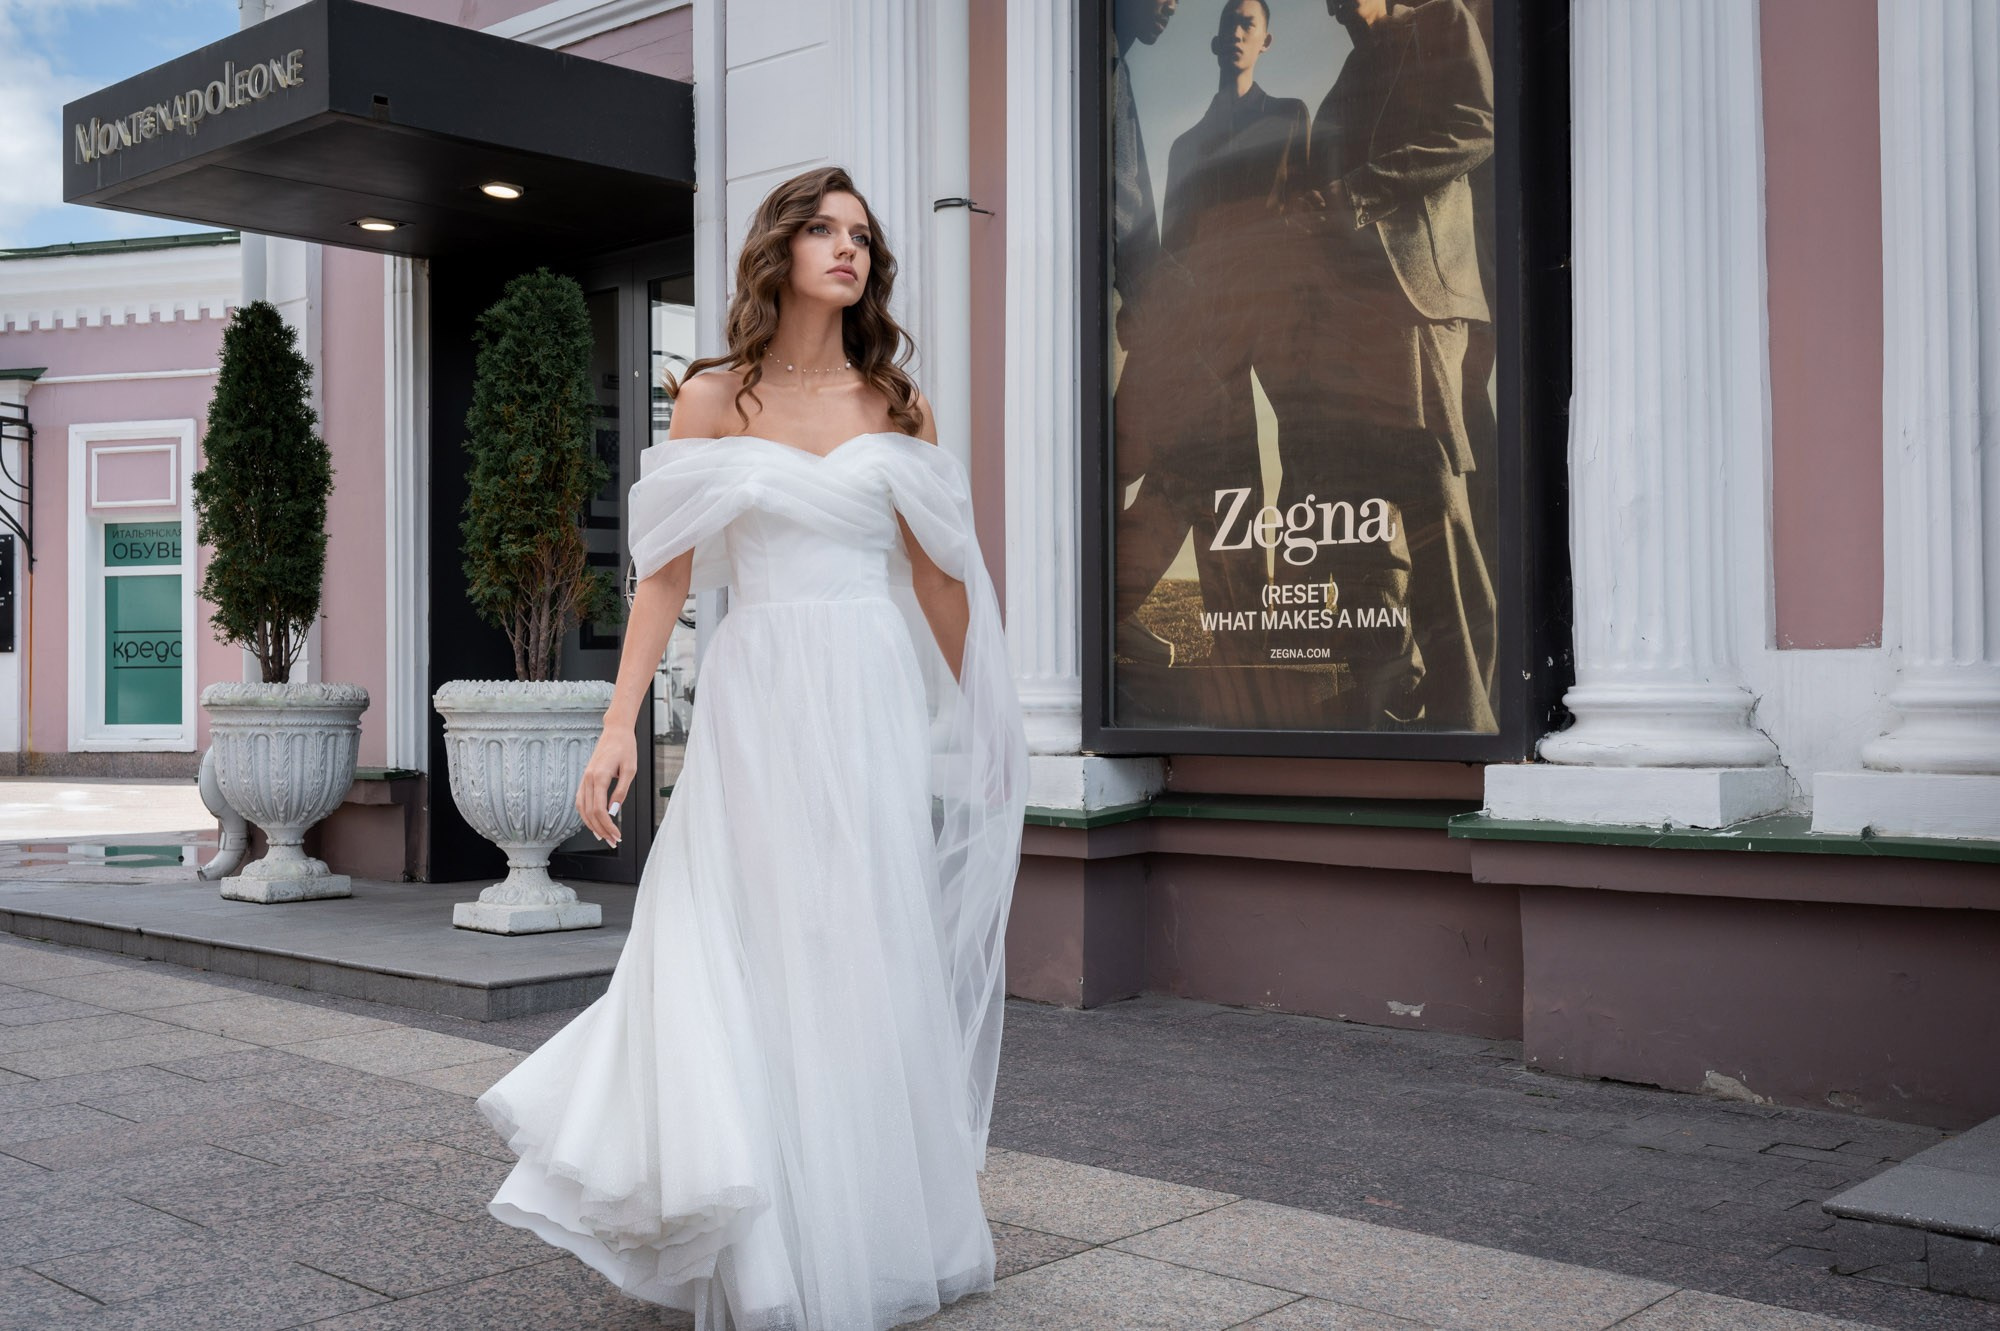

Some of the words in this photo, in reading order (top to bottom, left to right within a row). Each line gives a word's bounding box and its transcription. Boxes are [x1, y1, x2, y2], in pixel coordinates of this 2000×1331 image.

[1209, 487, 1396, 566] Zegna
[112, 541, 182, 560] ОБУВЬ
[1261, 581, 1339, 608] (RESET)
[1200, 611, 1257, 631] WHAT
[1261, 609, 1334, 631] MAKES
[1337, 608, 1353, 629] A
[1357, 607, 1408, 628] MAN
[1270, 648, 1331, 659] ZEGNA.COM
